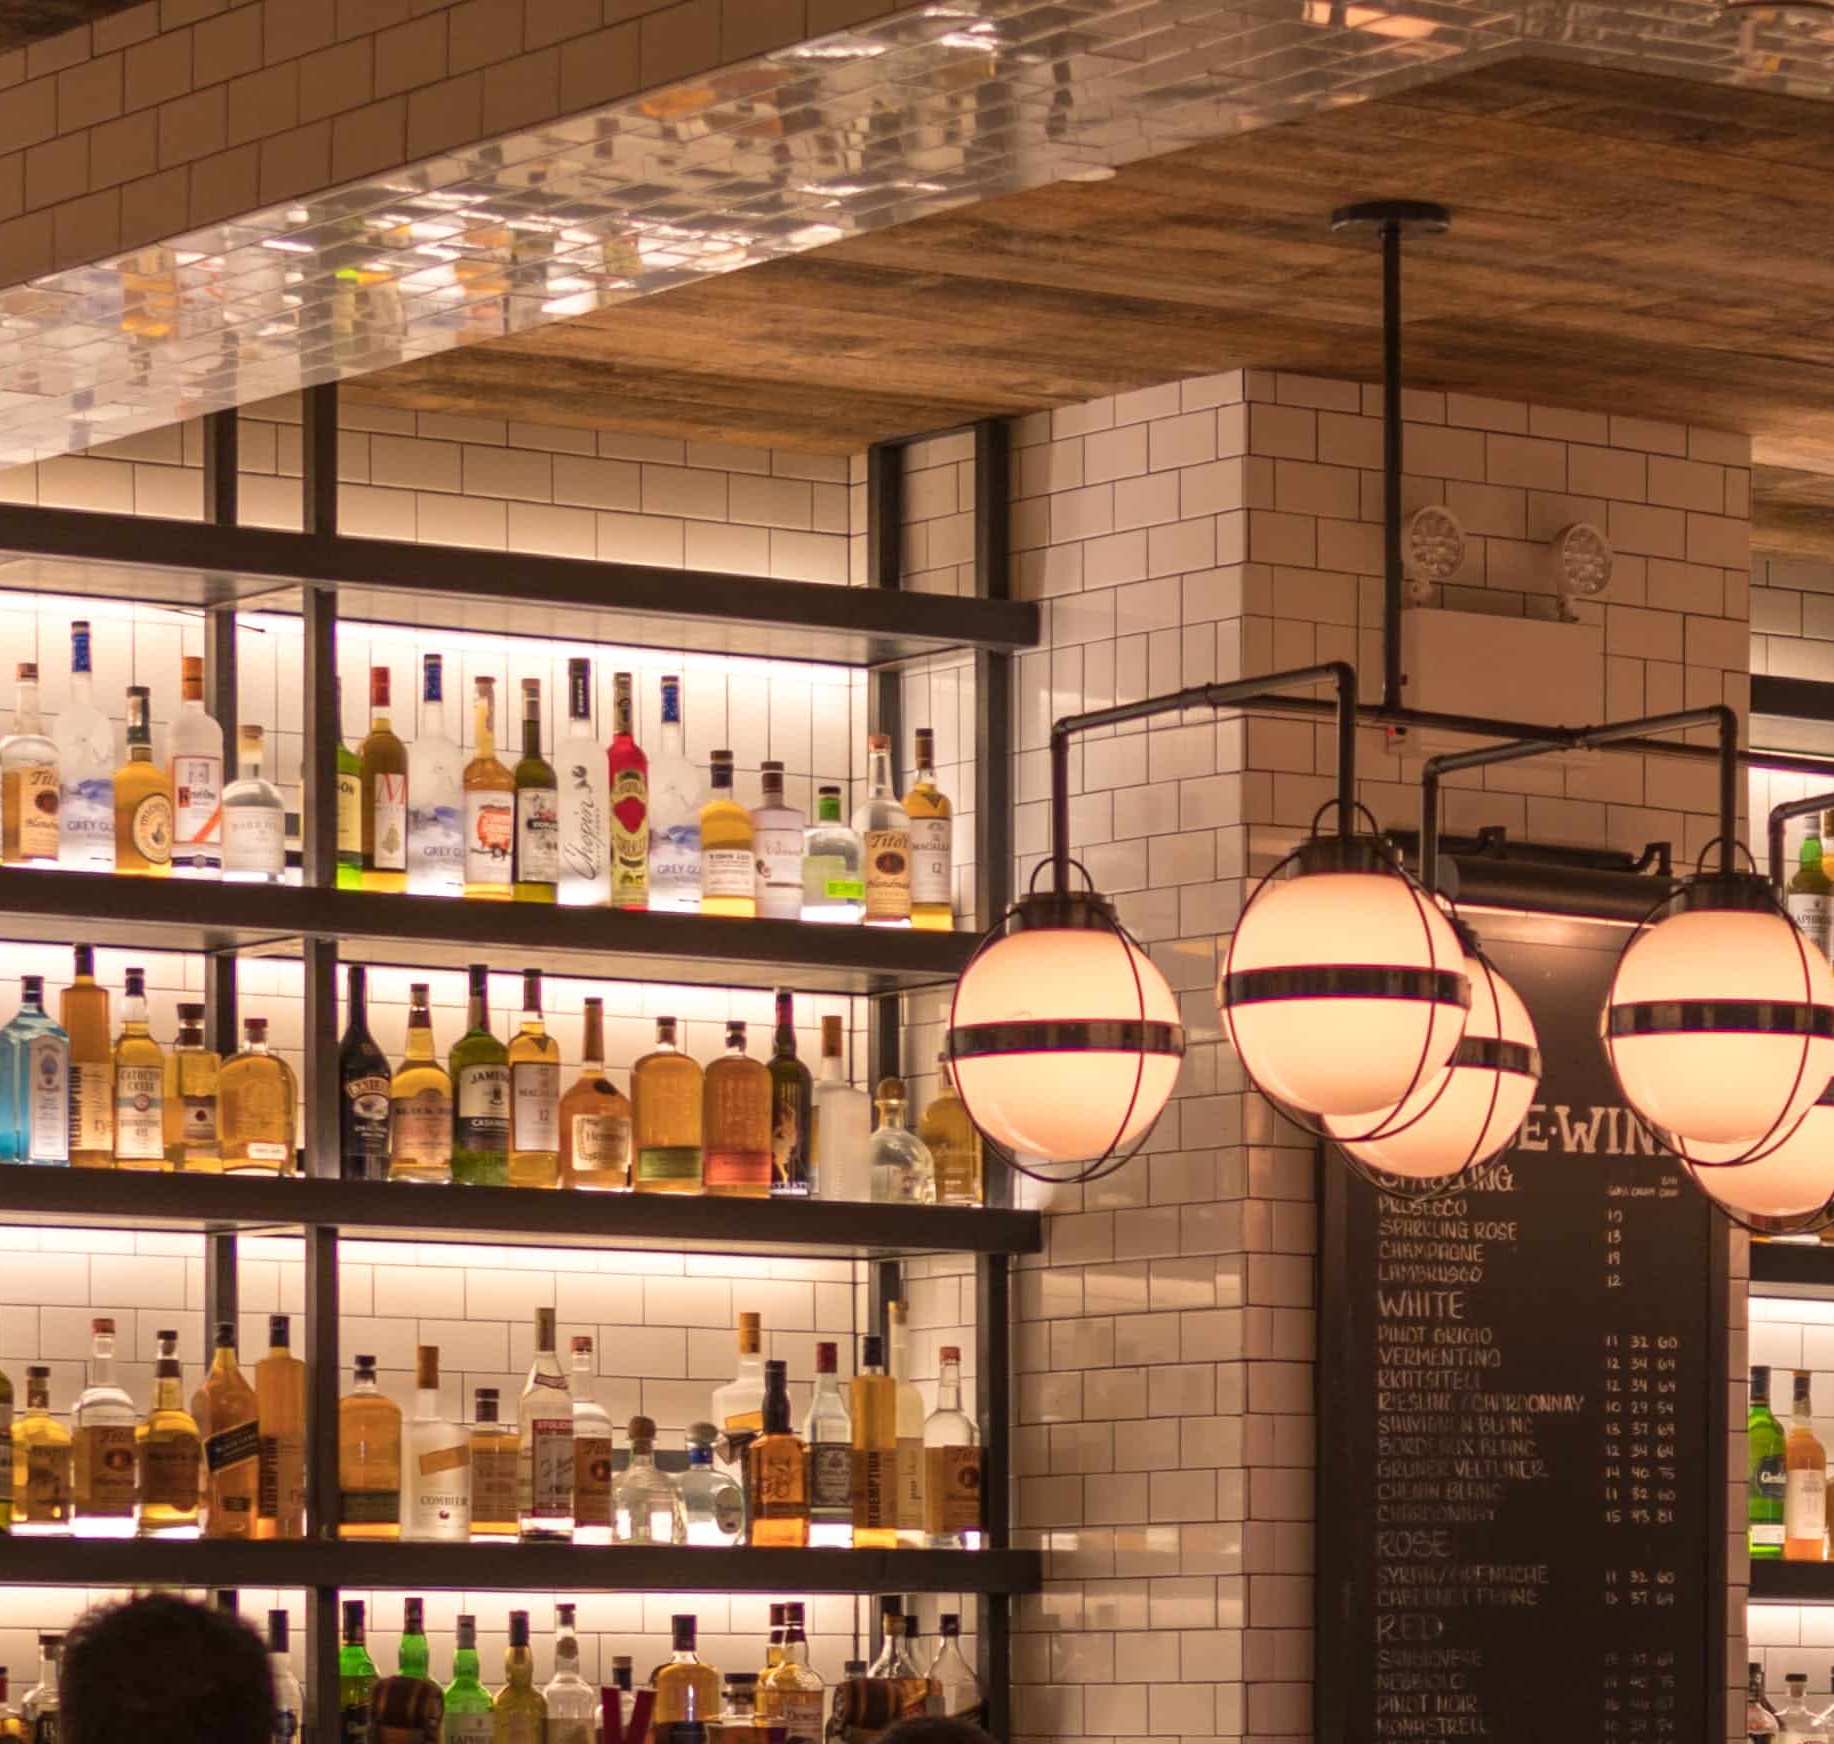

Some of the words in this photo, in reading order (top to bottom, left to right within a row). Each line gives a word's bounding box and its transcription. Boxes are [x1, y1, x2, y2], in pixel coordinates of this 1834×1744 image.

[68, 820, 96, 833] GREY
[424, 845, 453, 858] GREY
[657, 863, 686, 875] GREY
[69, 1065, 82, 1148] REDEMPTION
[538, 1108, 550, 1122] 12
[1377, 1289, 1467, 1320] WHITE
[1379, 1346, 1501, 1367] VERMENTINO
